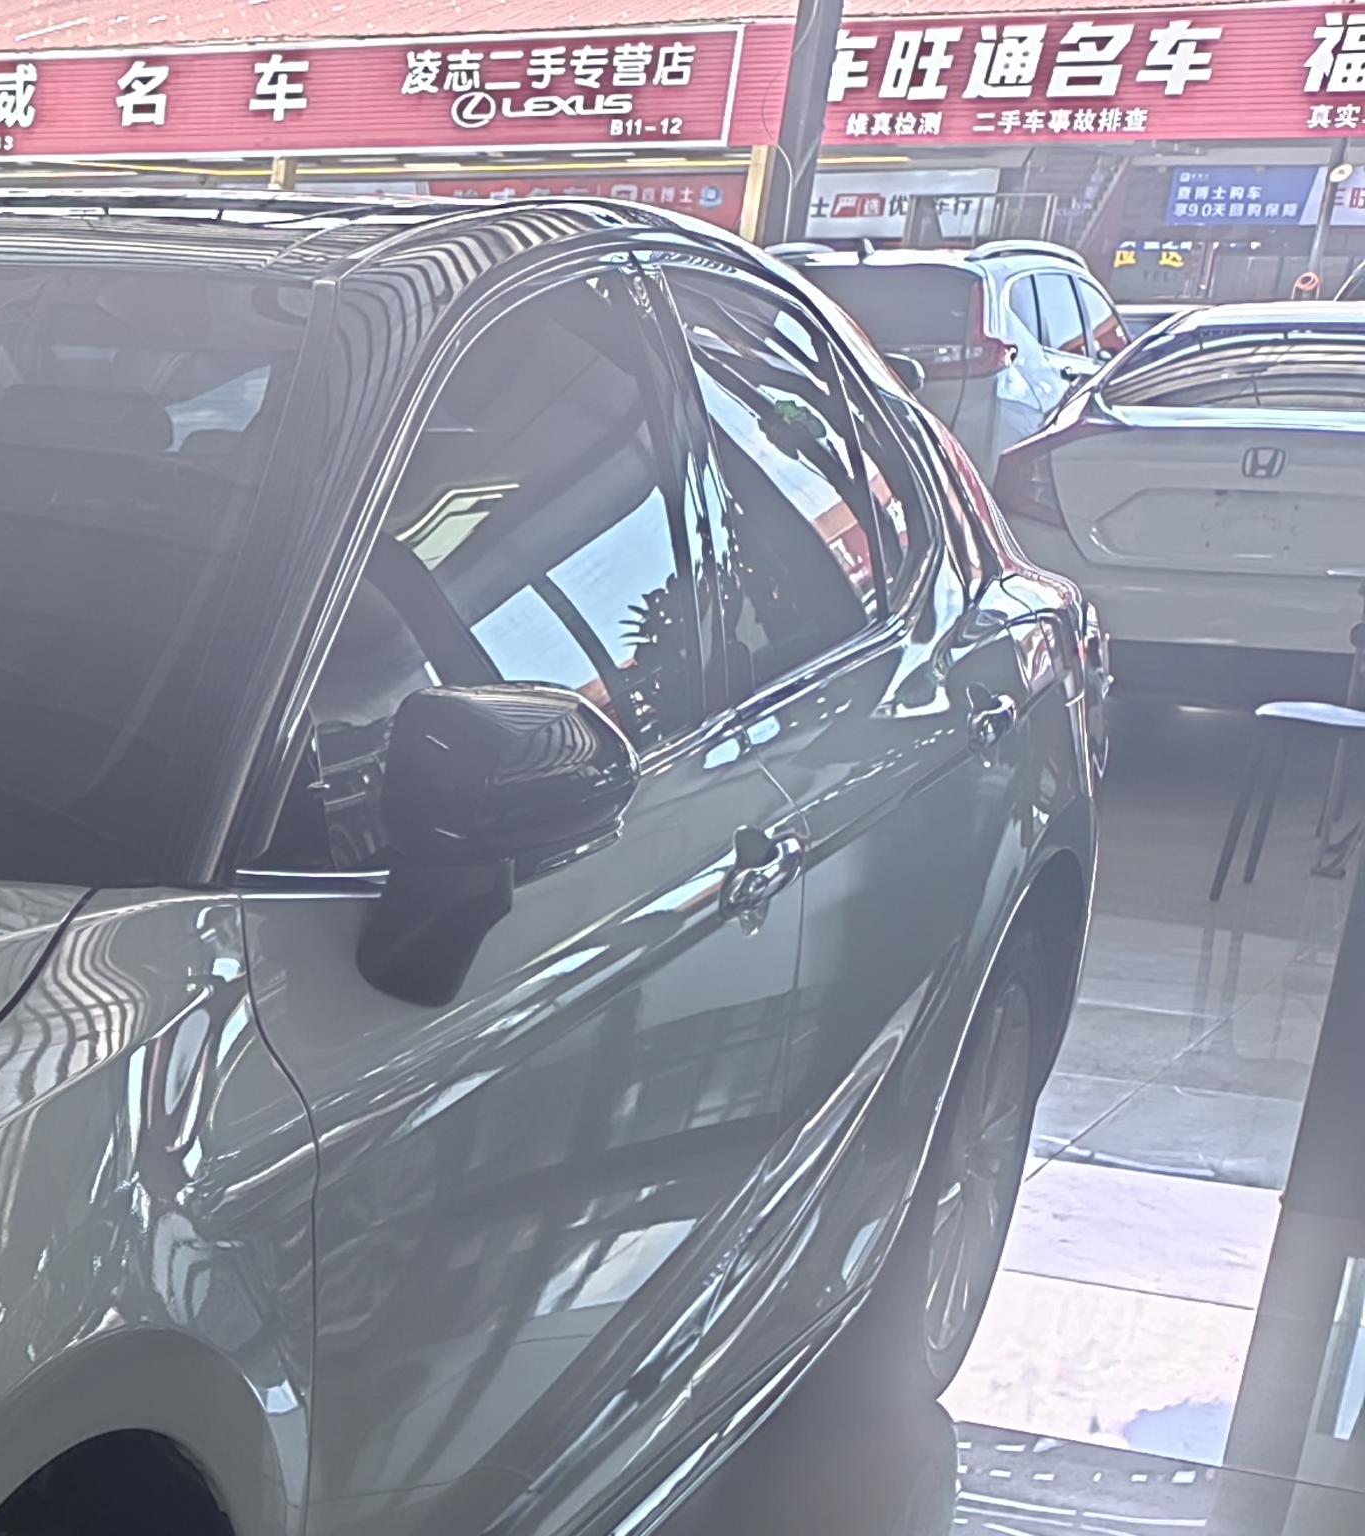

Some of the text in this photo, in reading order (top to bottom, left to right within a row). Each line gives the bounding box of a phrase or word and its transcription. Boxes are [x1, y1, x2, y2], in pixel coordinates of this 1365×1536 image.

[401, 42, 697, 95] 凌志二手专营店
[502, 94, 633, 118] LEXUS
[1307, 104, 1365, 128] 真实
[610, 118, 683, 136] B11-12
[973, 107, 1148, 134] 二手车事故排查
